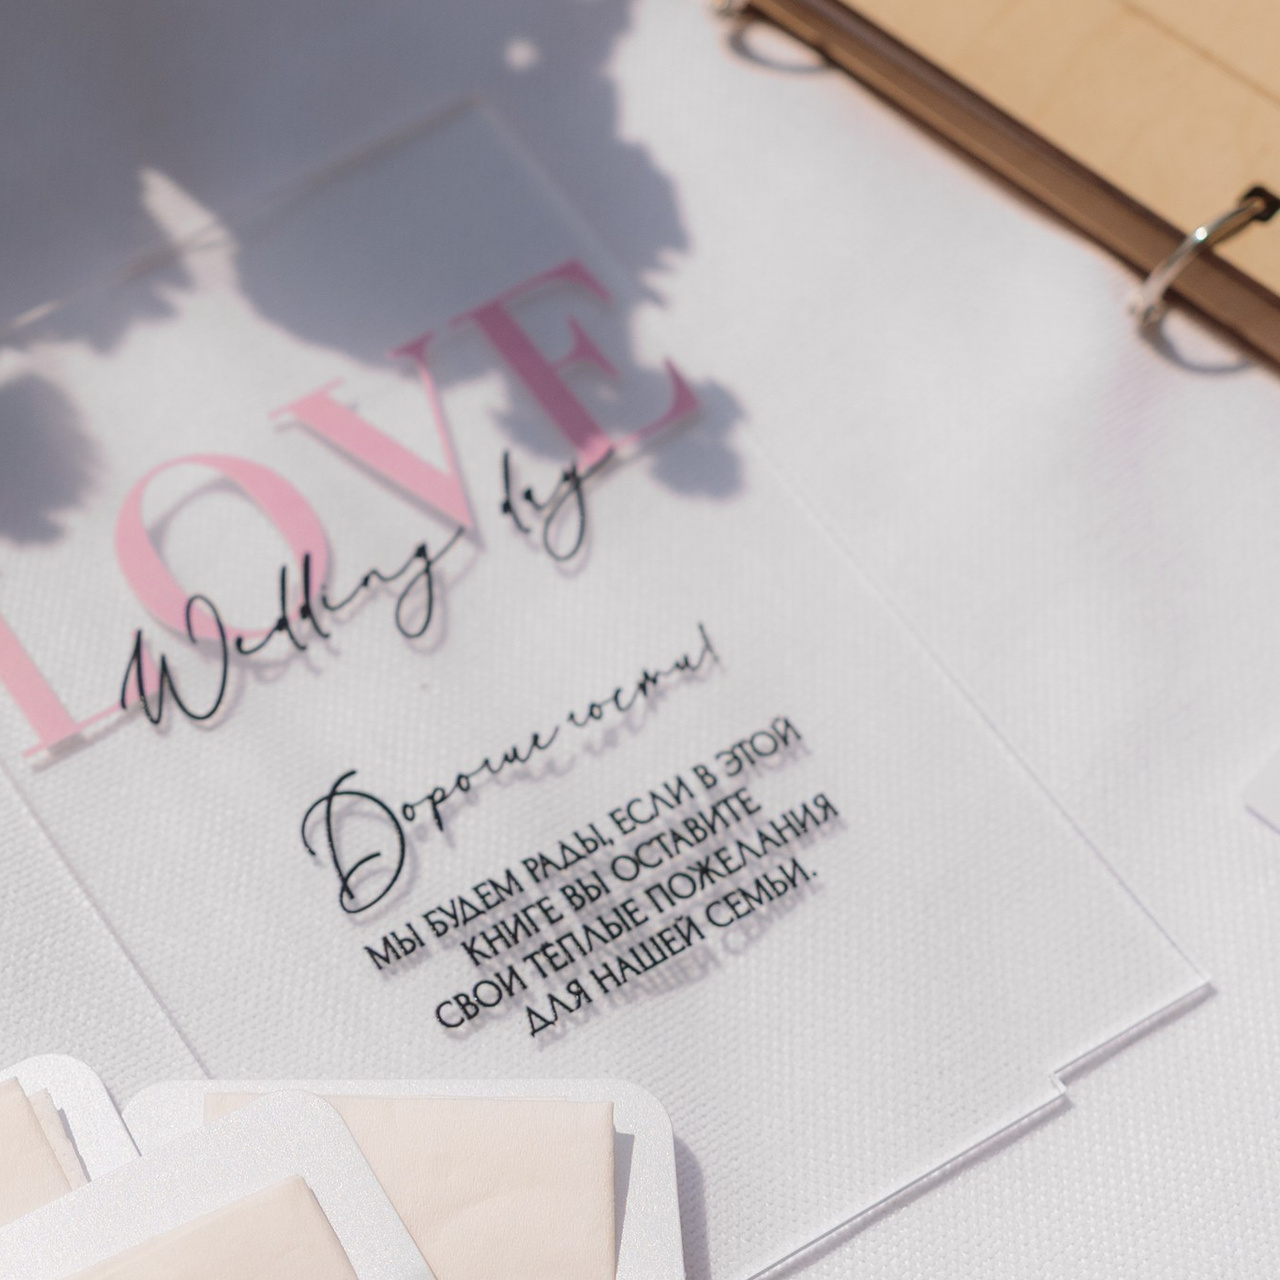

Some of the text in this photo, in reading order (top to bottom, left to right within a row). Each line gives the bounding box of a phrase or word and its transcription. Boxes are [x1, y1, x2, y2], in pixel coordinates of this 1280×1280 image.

[120, 526, 465, 724] Wedding
[302, 725, 560, 914] Дорогие
[363, 715, 803, 971] МЫ БУДЕМ РАДЫ, ЕСЛИ В ЭТОЙ
[435, 964, 528, 1029] СВОИ
[644, 793, 839, 914] ПОЖЕЛАНИЯ
[460, 786, 762, 967] КНИГЕ ВЫ ОСТАВИТЕ
[526, 857, 818, 1037] ДЛЯ НАШЕЙ СЕМЬИ.
